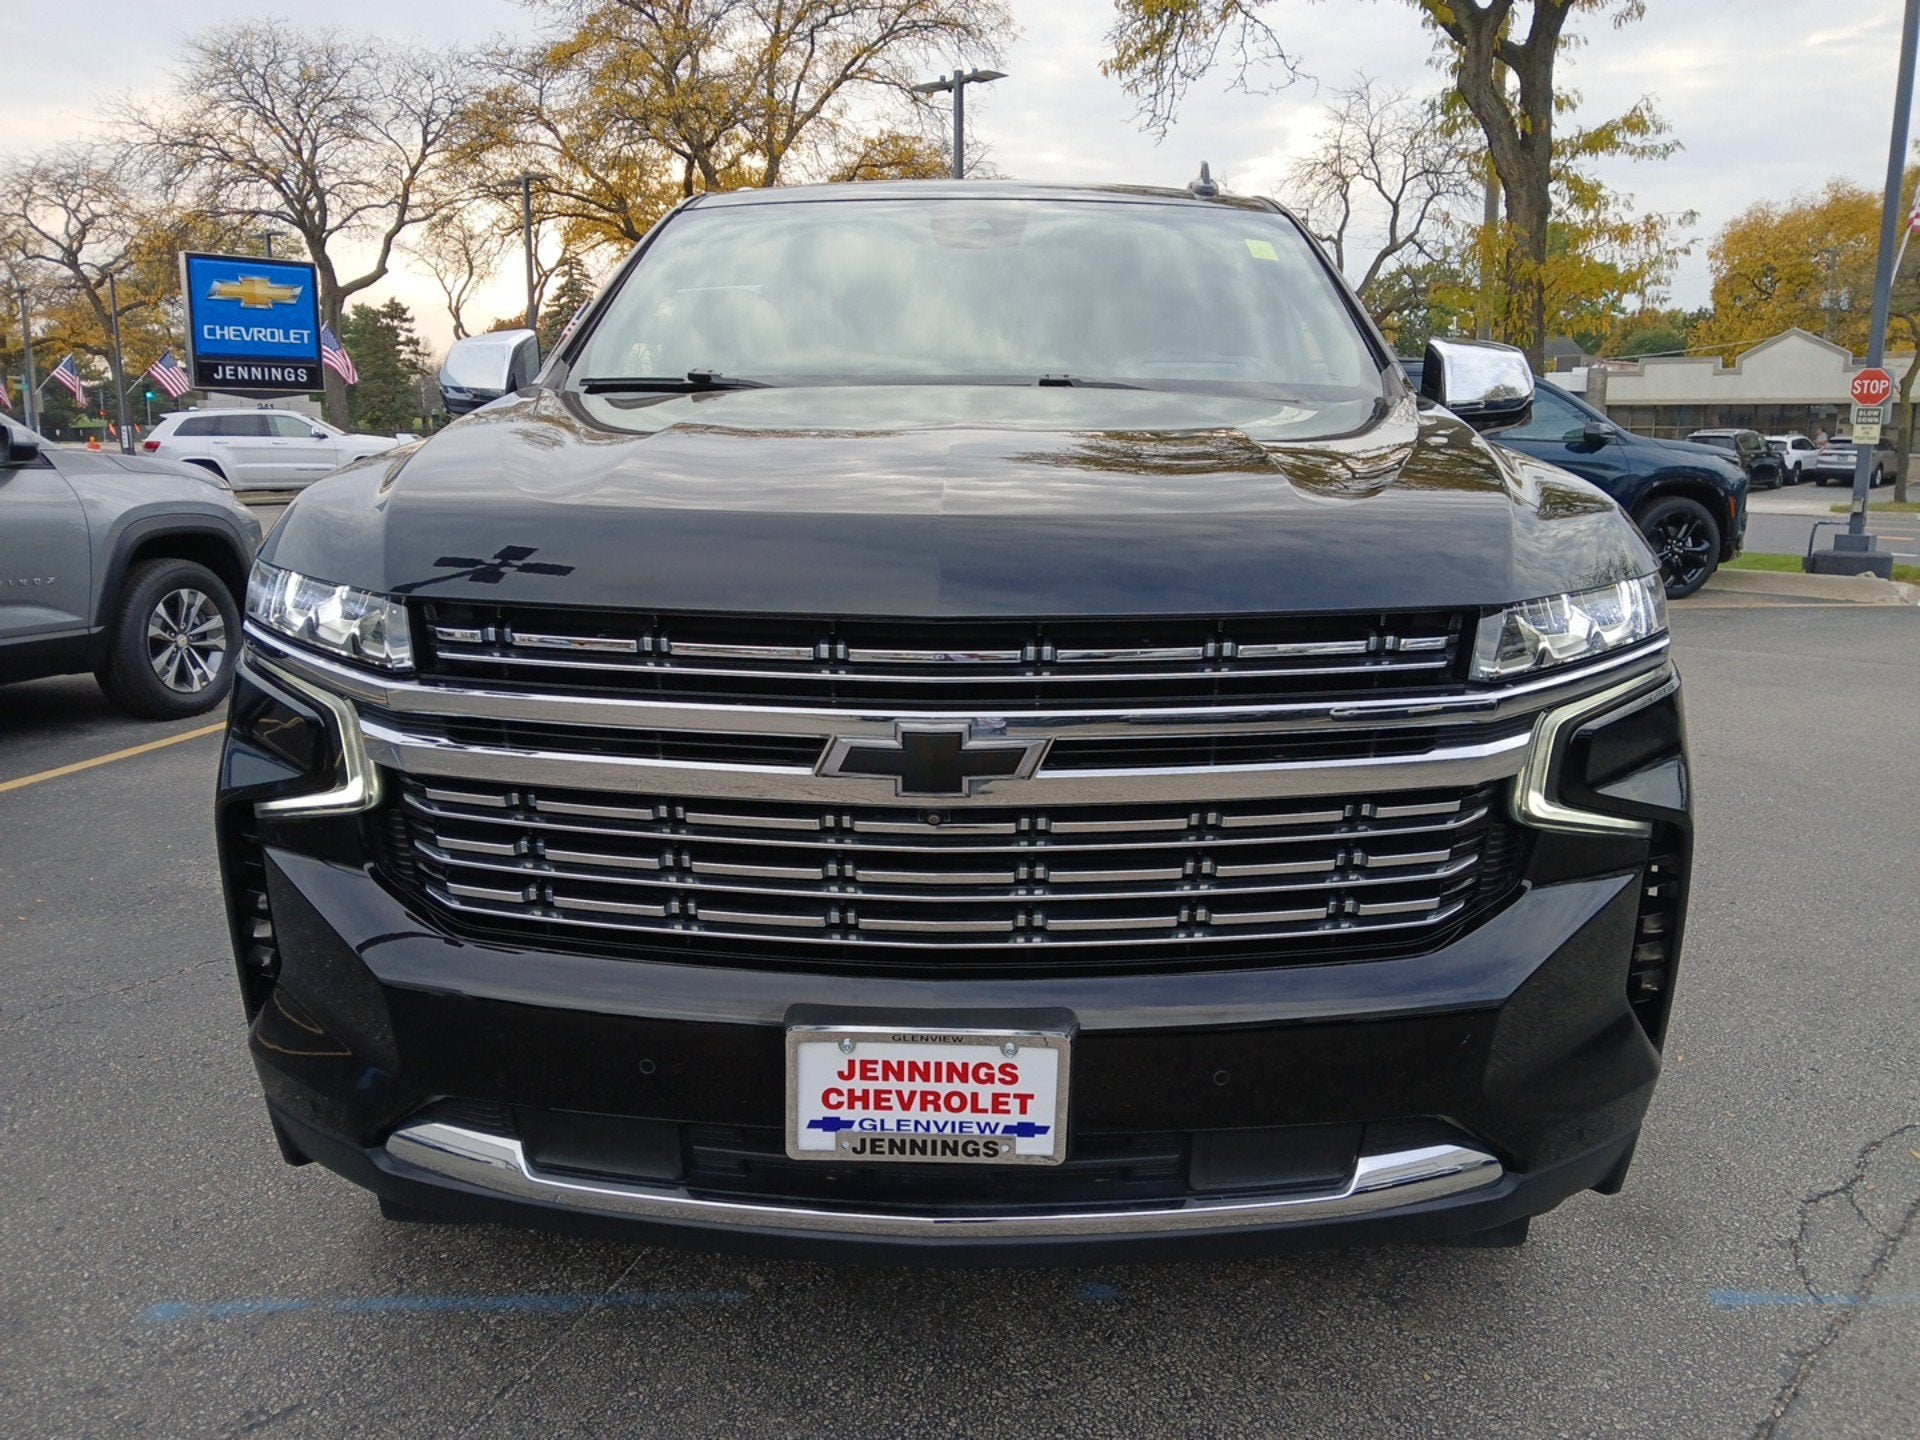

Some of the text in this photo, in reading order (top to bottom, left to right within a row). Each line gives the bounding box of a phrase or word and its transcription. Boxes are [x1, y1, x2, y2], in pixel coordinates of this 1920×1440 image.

[203, 324, 311, 344] CHEVROLET
[213, 365, 308, 382] JENNINGS
[1852, 379, 1889, 394] STOP
[891, 1034, 964, 1043] GLENVIEW
[837, 1059, 1020, 1086] JENNINGS
[821, 1087, 1035, 1115] CHEVROLET
[858, 1118, 1000, 1135] GLENVIEW
[851, 1138, 999, 1158] JENNINGS
